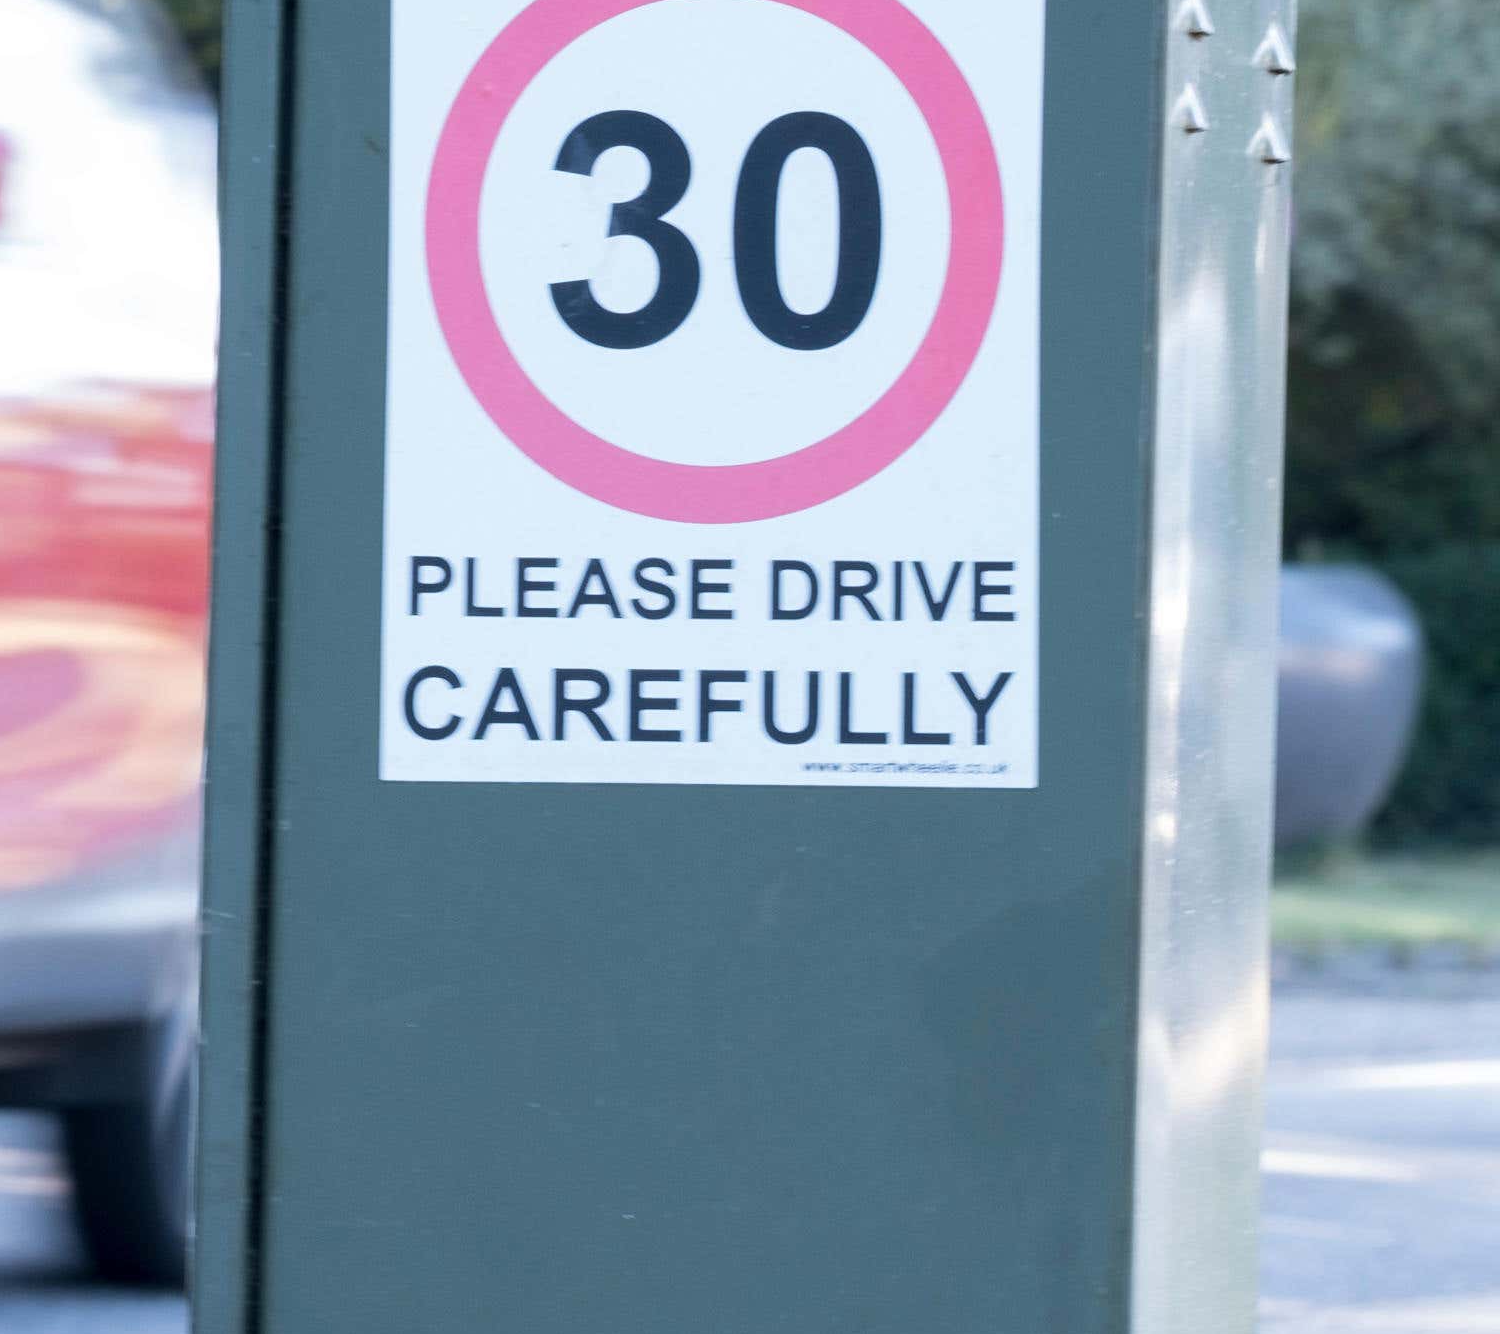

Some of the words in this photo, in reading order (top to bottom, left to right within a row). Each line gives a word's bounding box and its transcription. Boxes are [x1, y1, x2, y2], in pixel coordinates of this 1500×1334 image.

[549, 110, 882, 350] 30
[409, 555, 734, 621] PLEASE
[771, 559, 1017, 623] DRIVE
[403, 664, 1013, 746] CAREFULLY
